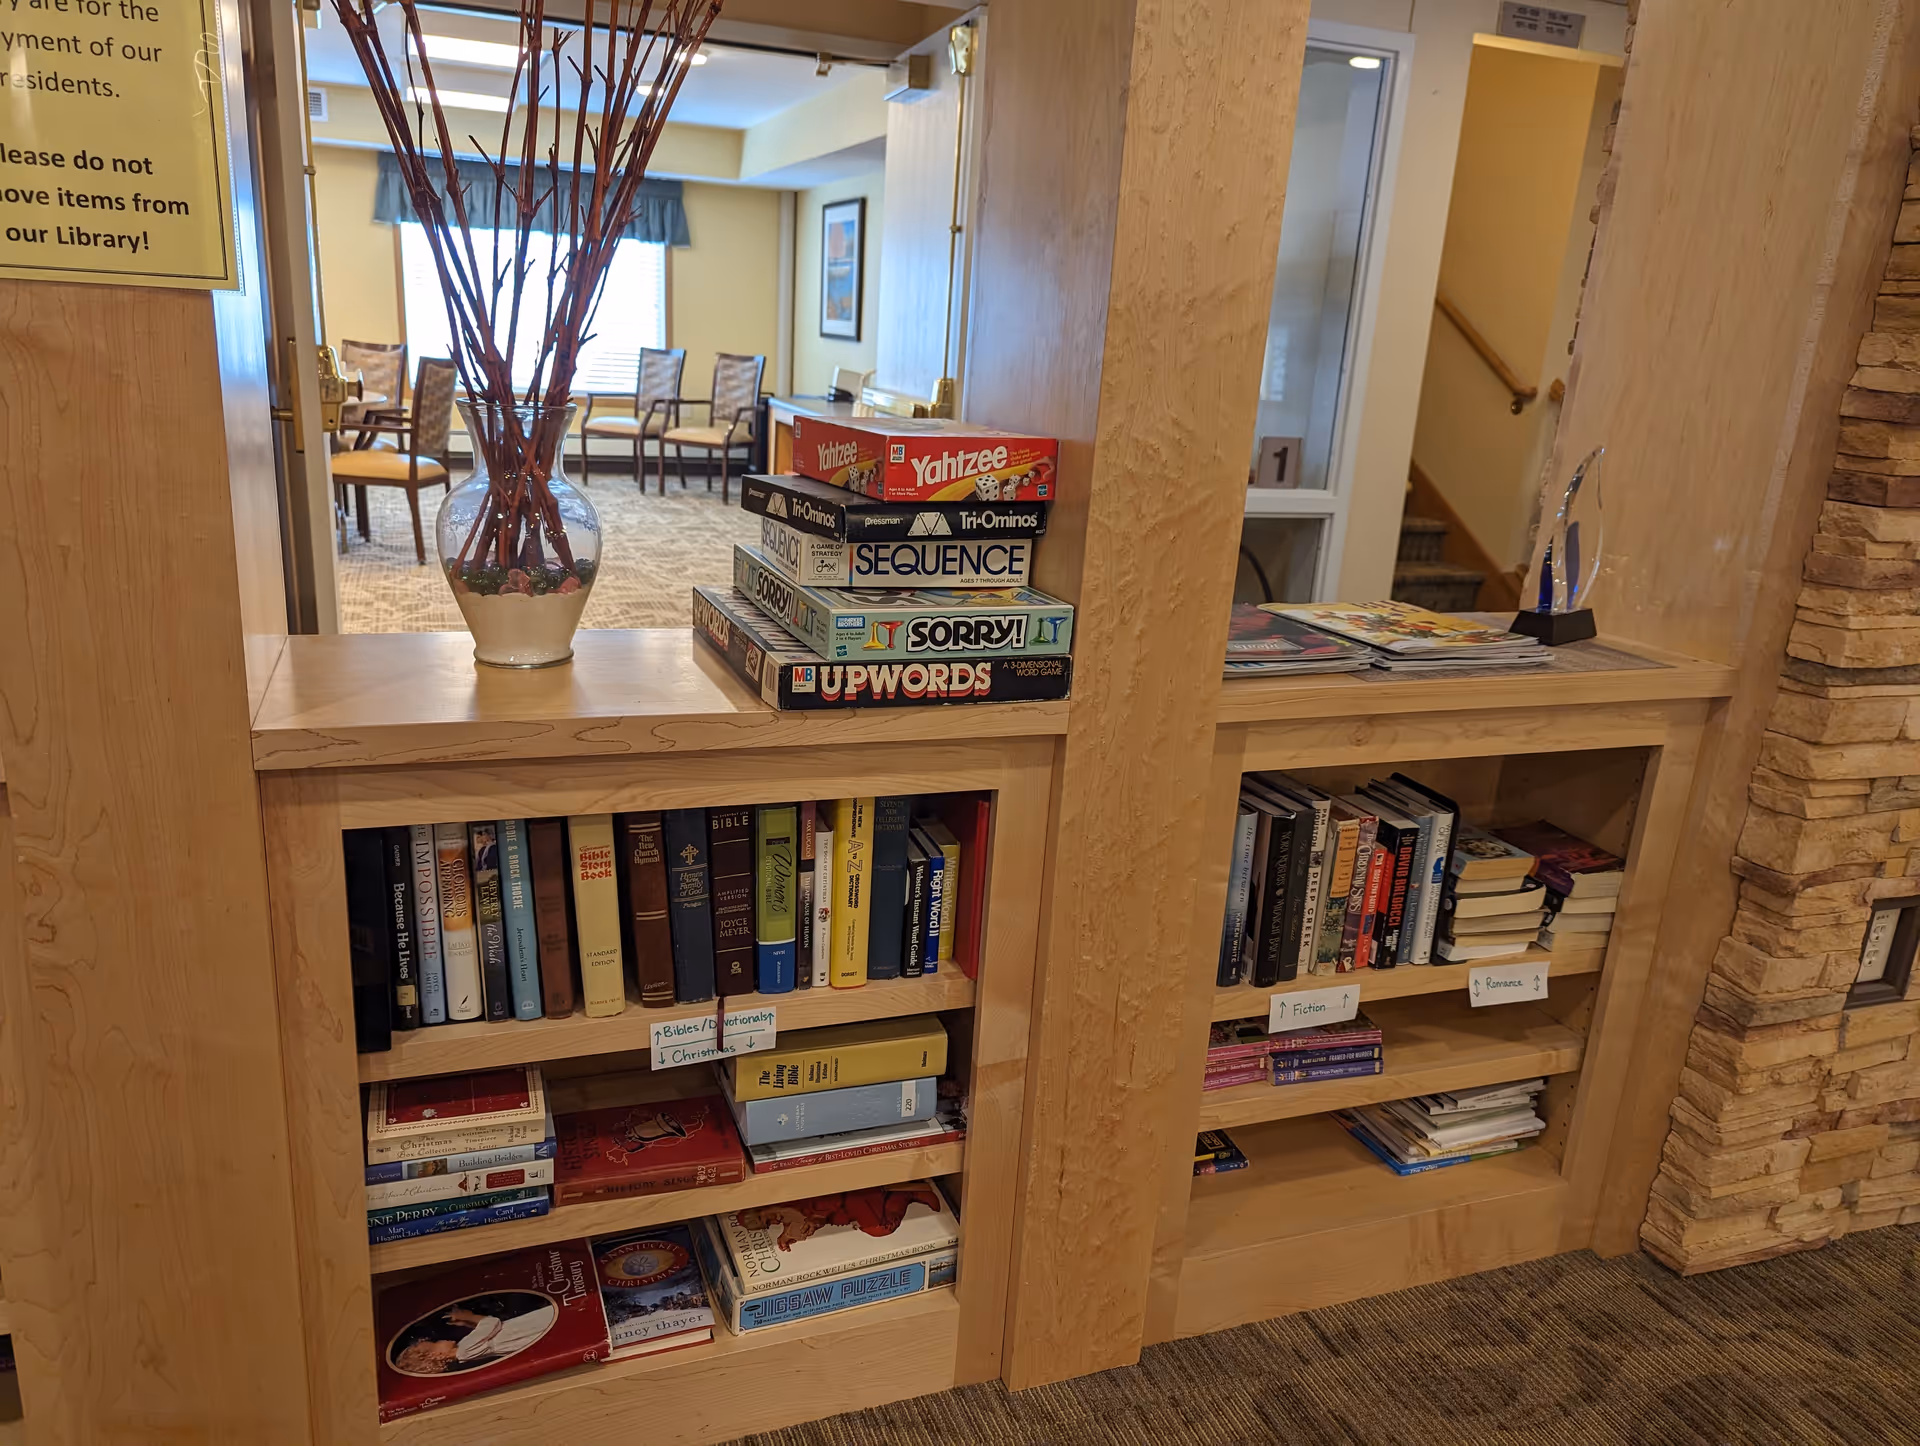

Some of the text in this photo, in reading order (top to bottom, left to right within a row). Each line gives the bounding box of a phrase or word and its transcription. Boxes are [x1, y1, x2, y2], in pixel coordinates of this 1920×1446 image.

[76, 0, 111, 17] for
[120, 2, 159, 22] the
[1, 31, 162, 63] yment of our
[0, 71, 121, 98] residents.
[73, 150, 104, 171] do
[112, 155, 154, 176] not
[0, 187, 190, 216] ove items from
[5, 225, 150, 254] our Library!
[818, 441, 857, 471] Yahtzee
[911, 446, 1007, 486] Yahtzee
[1273, 444, 1290, 483] 1
[855, 544, 1025, 575] SEQUENCE
[756, 568, 794, 624] SORRY!
[909, 616, 1026, 651] SORRY!
[1010, 660, 1063, 671] 3-DIMENSIONAL
[1016, 667, 1062, 677] WORD GAME
[820, 662, 991, 701] UPWORDS
[713, 816, 749, 830] BIBLE
[1311, 809, 1321, 847] HOUSTON
[638, 834, 654, 842] The
[638, 841, 655, 850] New
[848, 840, 864, 853] A
[1280, 831, 1292, 848] NORA
[579, 849, 611, 862] Bible
[634, 848, 659, 858] Church
[634, 856, 660, 866] Hymnal
[1243, 844, 1251, 863] time
[508, 854, 520, 879] BROCK
[580, 860, 612, 871] Story
[581, 870, 612, 881] Book
[847, 860, 863, 873] Z
[440, 859, 455, 918] APPEARING
[451, 858, 468, 918] GLORIOUS
[772, 846, 792, 912] Women's
[914, 865, 924, 897] Webster's
[1239, 867, 1250, 903] between
[1388, 847, 1412, 926] DAVID BALDACCI
[416, 843, 437, 961] IMPOSSIBLE
[481, 886, 490, 915] LEWIS
[488, 880, 499, 917] BEVERLY
[688, 887, 703, 896] God
[717, 888, 750, 897] AMPLIFIED
[720, 893, 747, 901] VERSION
[929, 869, 944, 929] Right Word
[393, 883, 406, 929] Because
[912, 898, 922, 924] Instant
[1303, 872, 1319, 947] DEEP CREEK
[719, 927, 751, 938] MEYER
[720, 917, 748, 929] JOYCE
[397, 929, 408, 947] He
[911, 925, 920, 944] Word
[1230, 913, 1243, 967] KAREN WHITE
[398, 949, 409, 980] Lives
[586, 949, 618, 958] STANDARD
[591, 959, 615, 967] EDITION
[909, 944, 919, 966] Guide
[1486, 976, 1524, 990] Romance
[1293, 1003, 1326, 1016] Fiction
[759, 1070, 770, 1086] The
[773, 1064, 787, 1089] Living
[788, 1065, 799, 1085] Bible
[905, 1098, 913, 1111] 220
[397, 1146, 457, 1159] Box Collection
[400, 1139, 452, 1151] Christmas
[862, 1144, 897, 1155] CHRISTMAS
[458, 1151, 525, 1168] Building Bridges
[396, 1207, 439, 1222] PERRY
[449, 1200, 489, 1212] CHRISTMAS
[496, 1207, 514, 1216] Carol
[608, 1242, 679, 1259] NANTUCKET
[733, 1230, 760, 1278] NORMAN
[607, 1264, 680, 1286] CHRISTMAS
[752, 1243, 937, 1292] NORMAN ROCKWELL'S CHRISTMAS BOOK
[564, 1261, 587, 1307] Treasury
[754, 1269, 912, 1319] JIGSAW PUZZLE
[615, 1326, 650, 1341] ancy
[656, 1313, 704, 1331] thayer
